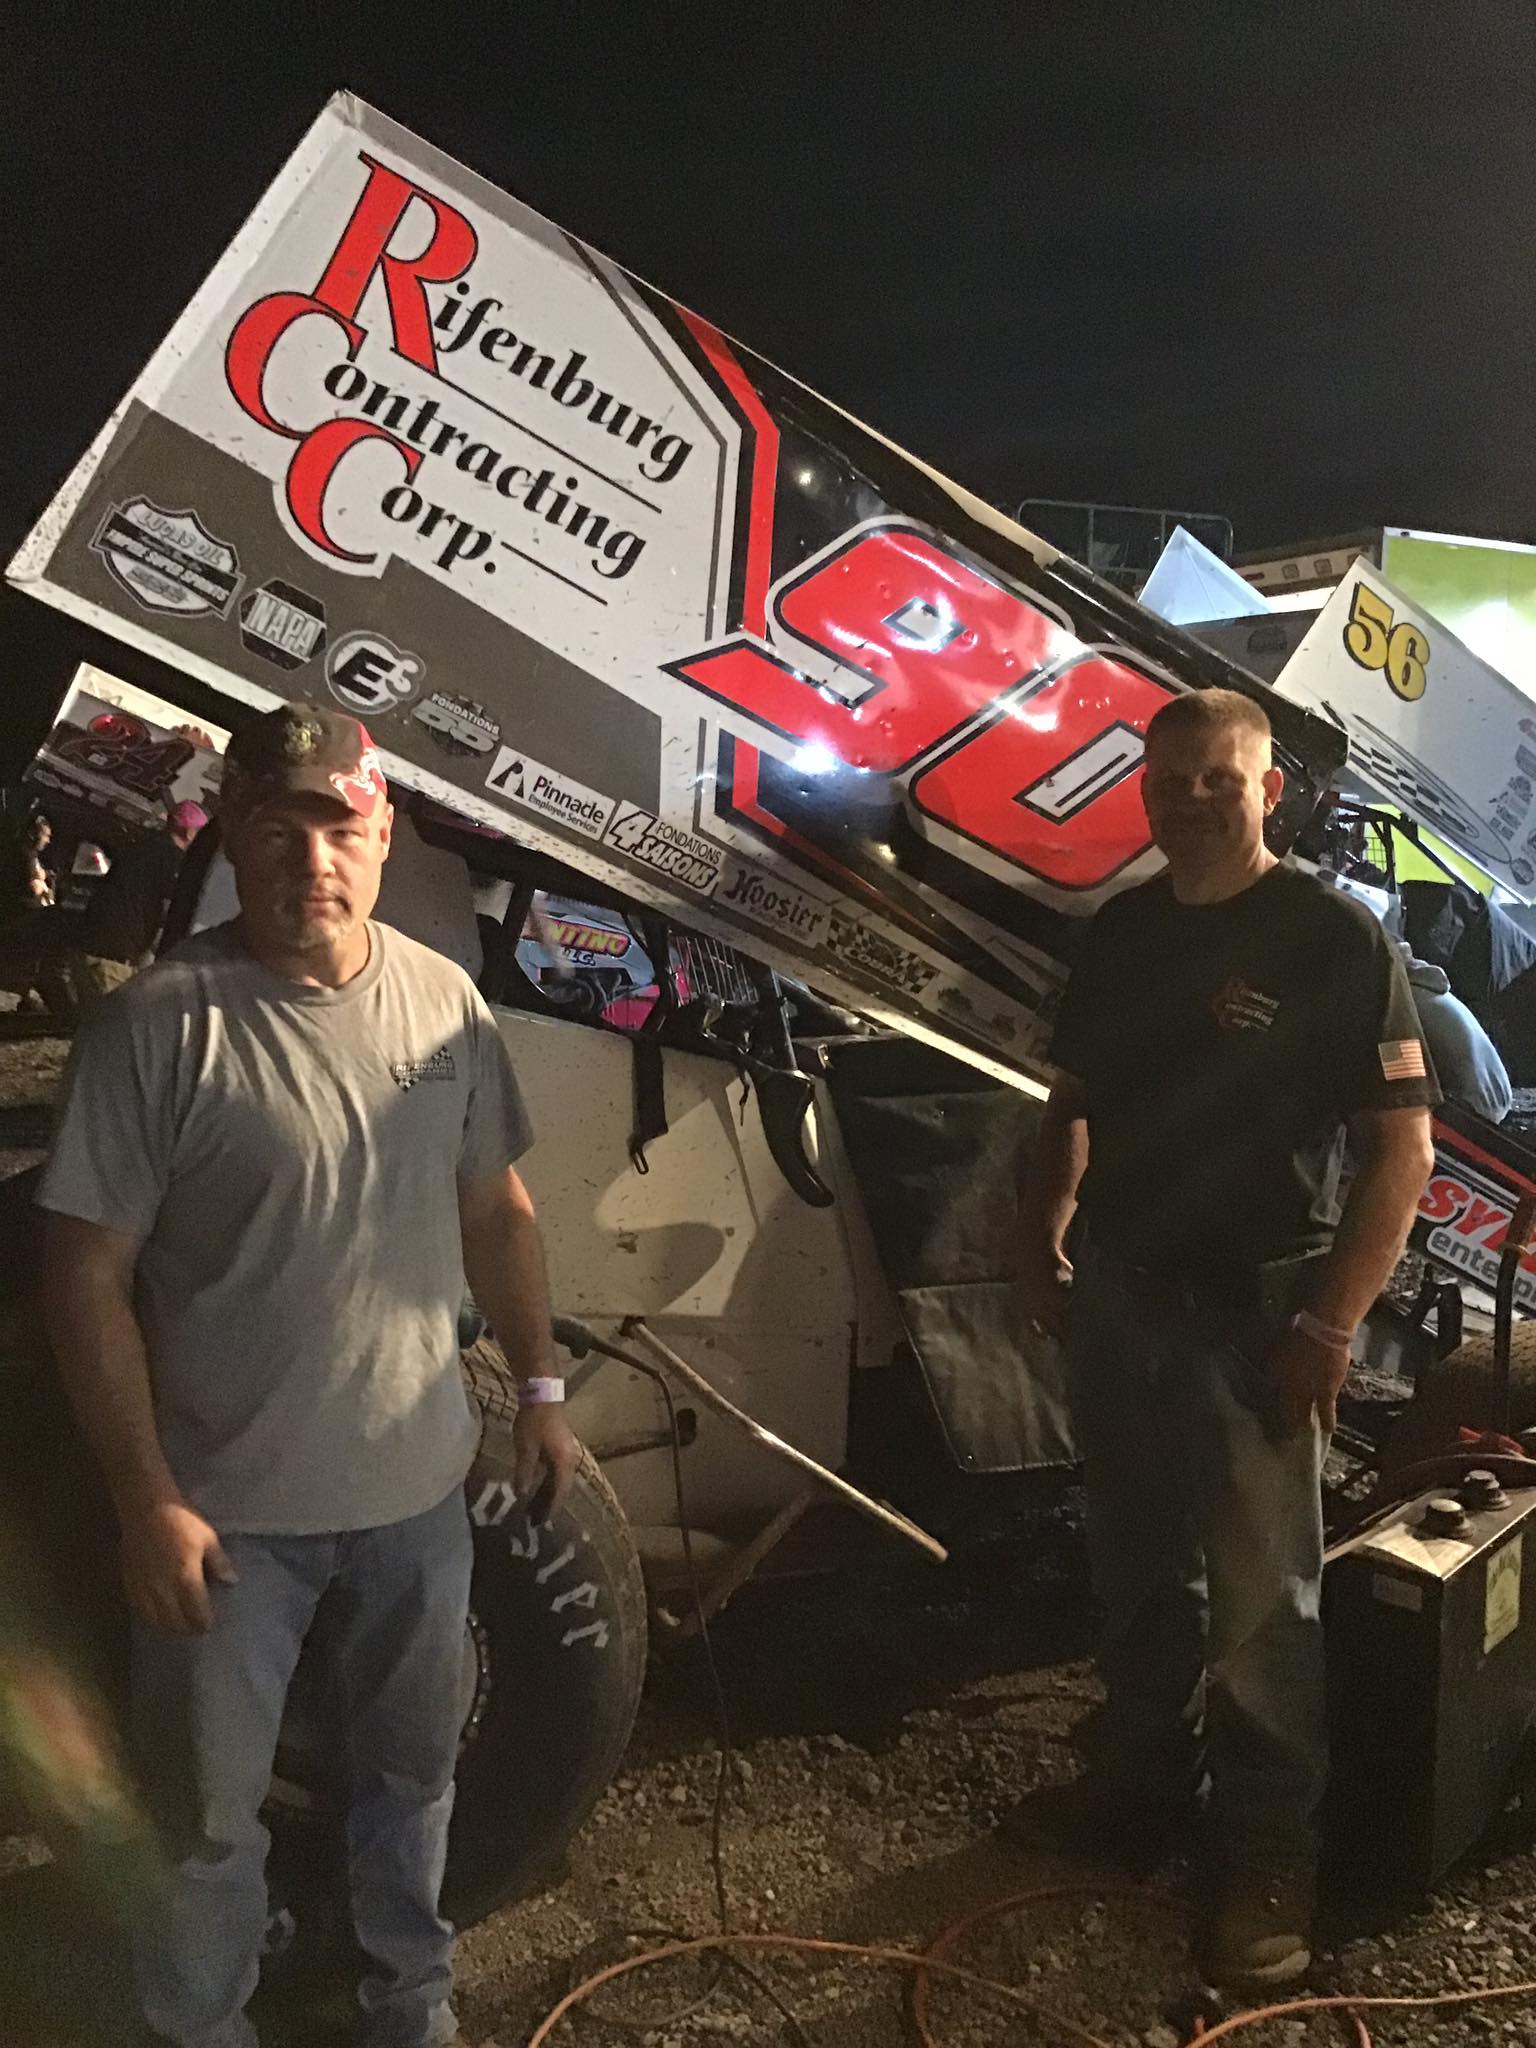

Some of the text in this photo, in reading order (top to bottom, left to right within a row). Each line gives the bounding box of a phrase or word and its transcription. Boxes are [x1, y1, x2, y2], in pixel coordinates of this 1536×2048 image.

[312, 150, 694, 484] Rifenburg
[225, 291, 647, 579] Contracting
[285, 417, 497, 573] Corp.
[249, 595, 320, 657] NAPA
[1342, 581, 1431, 703] 56
[432, 693, 500, 736] FONDATIONS
[660, 520, 1180, 893] 90
[528, 794, 598, 834] Employee Services
[532, 775, 605, 825] Pinnacle
[608, 810, 658, 854] 4
[634, 836, 720, 890] SAISONS
[656, 821, 722, 866] FONDATIONS
[723, 868, 825, 933] Hoosier
